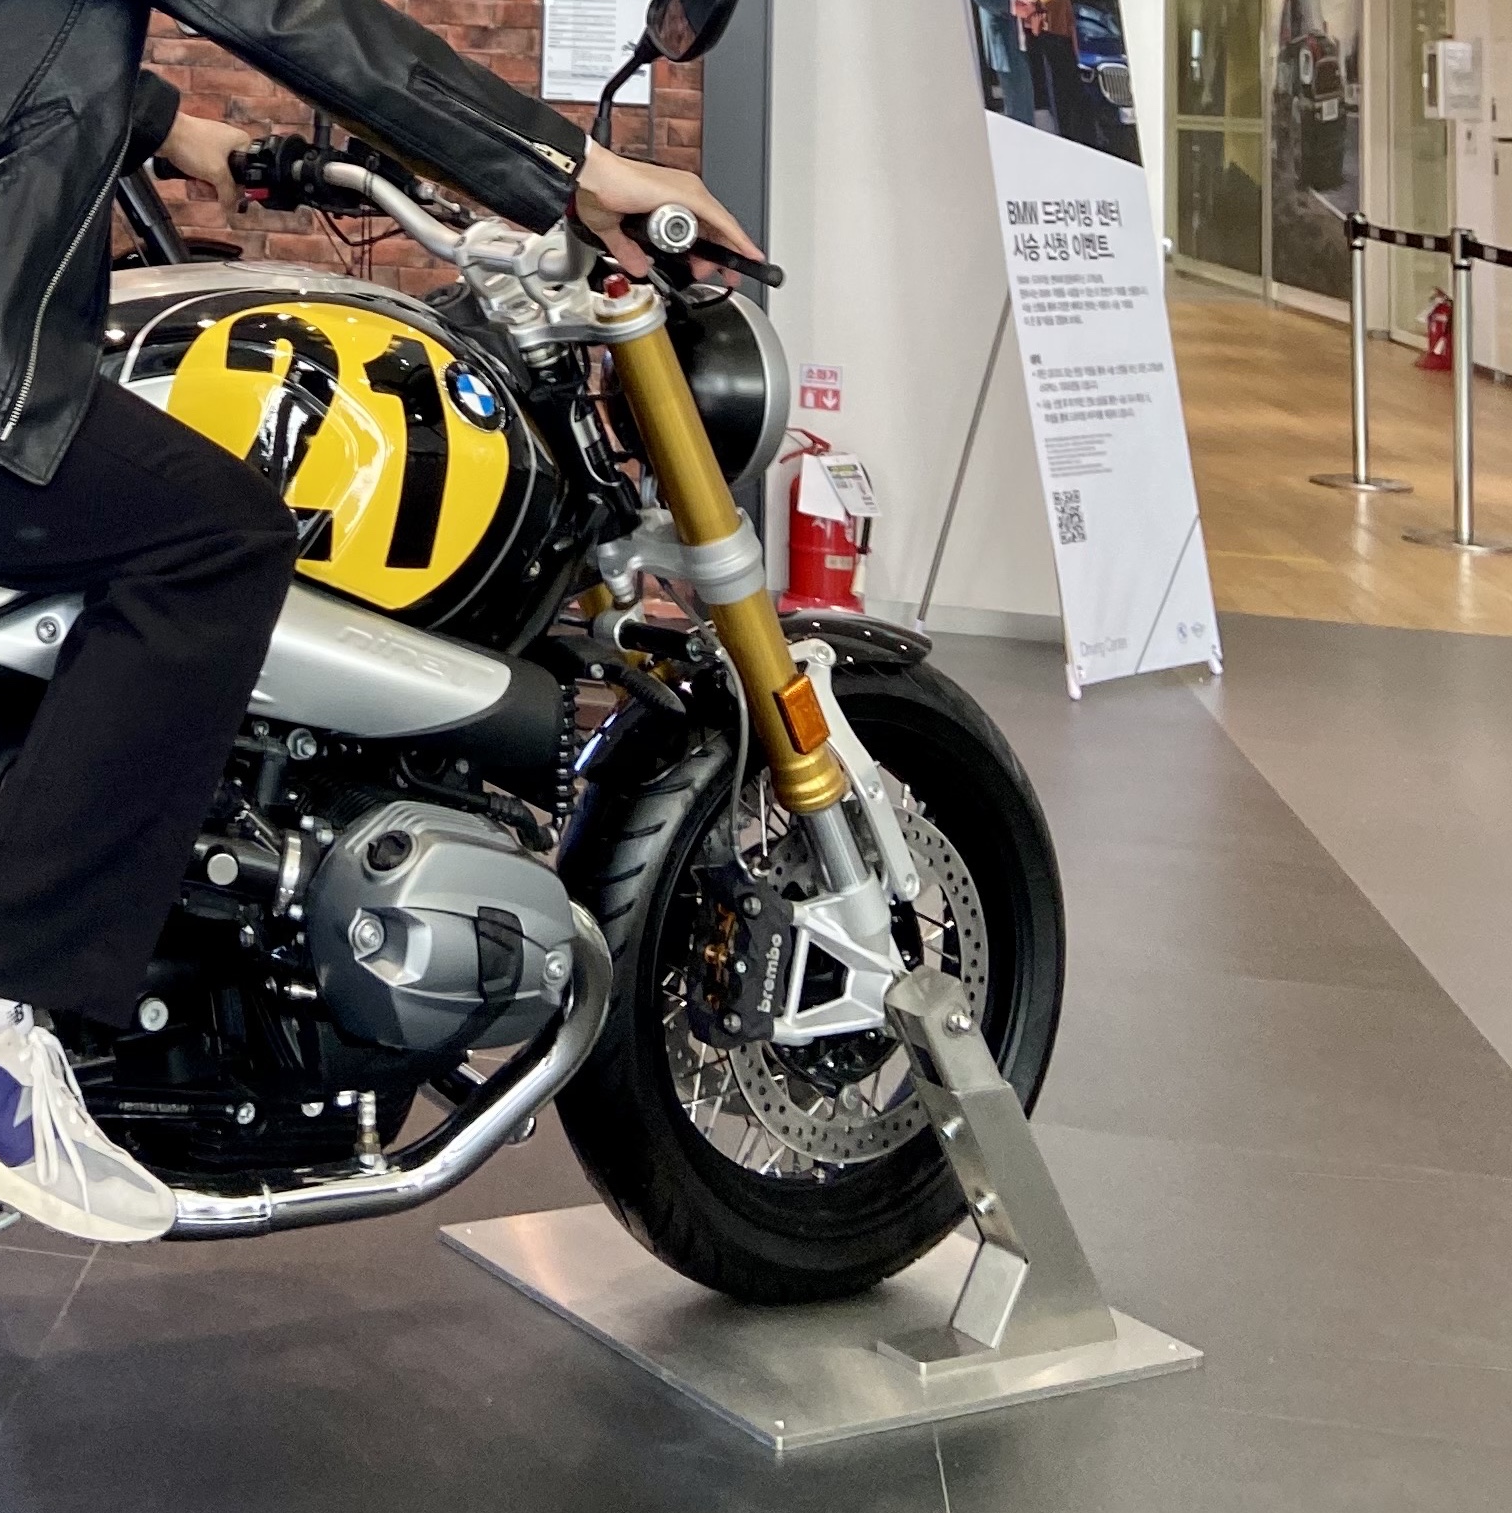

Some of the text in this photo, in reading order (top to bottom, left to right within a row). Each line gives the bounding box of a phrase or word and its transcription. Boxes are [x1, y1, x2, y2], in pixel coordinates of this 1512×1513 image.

[1006, 198, 1123, 227] BMW 드라이빙 센터
[1013, 232, 1116, 261] 시승 신청 이벤트
[756, 933, 783, 1014] brembo
